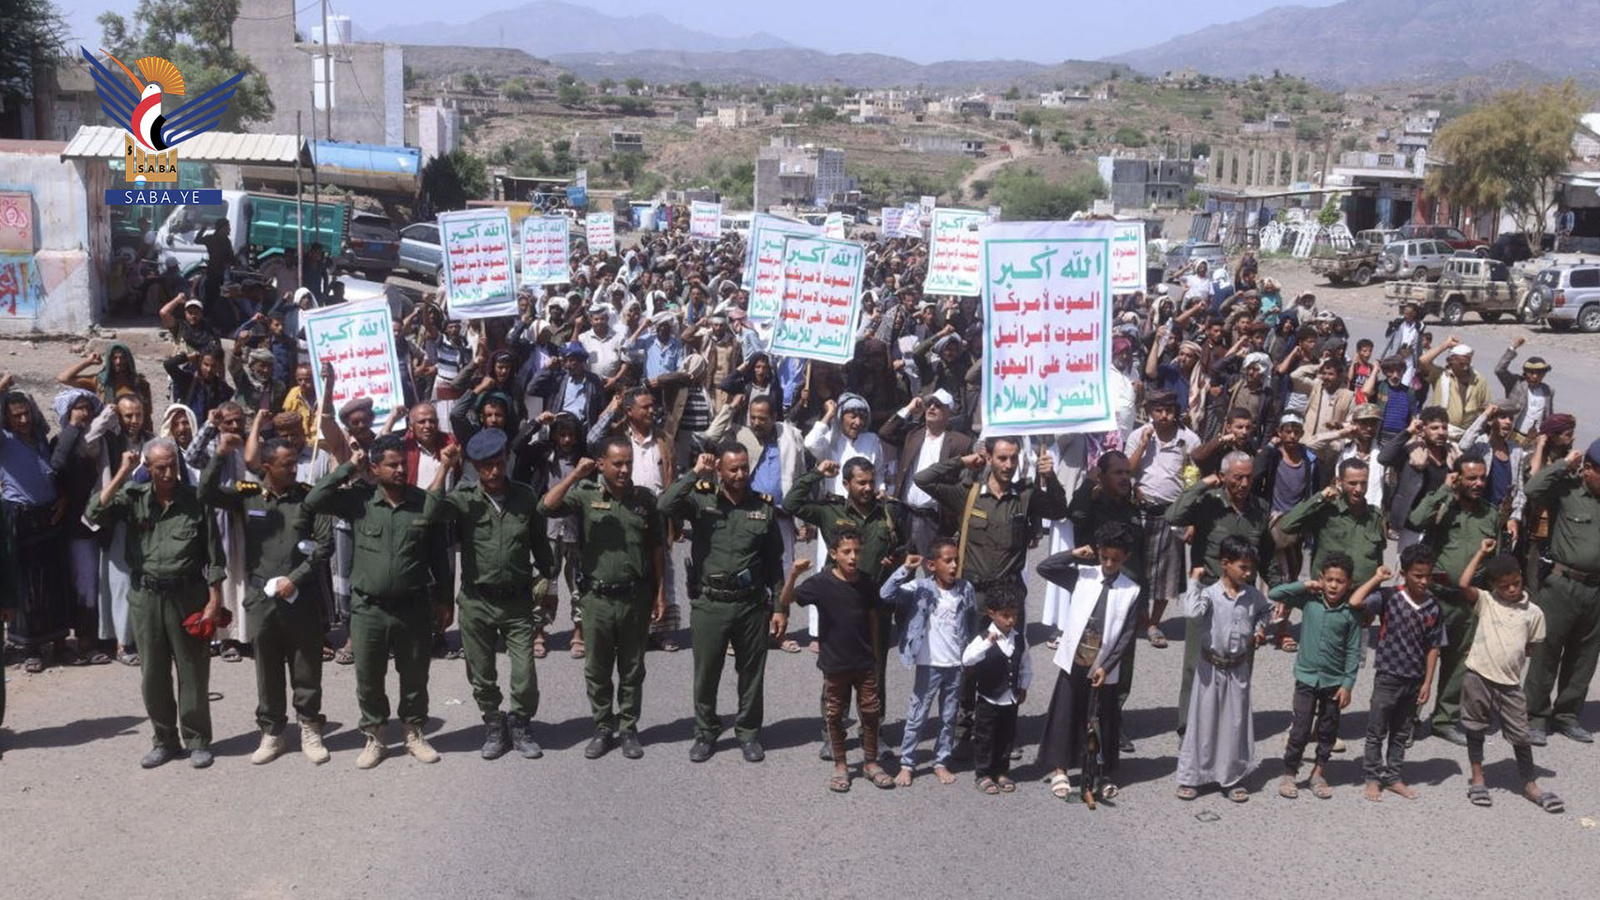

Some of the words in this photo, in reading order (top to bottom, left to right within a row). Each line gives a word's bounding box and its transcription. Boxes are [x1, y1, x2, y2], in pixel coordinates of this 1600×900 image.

[484, 223, 504, 237] الله
[831, 249, 857, 268] الله
[992, 245, 1058, 289] أكبر
[1060, 249, 1101, 279] الله
[823, 274, 855, 289] الموت
[821, 290, 852, 307] الموت
[993, 288, 1050, 317] لأمريكا
[1054, 291, 1100, 314] الموت
[779, 307, 805, 321] اليهود
[807, 311, 822, 324] على
[826, 311, 849, 326] اللعنة
[358, 318, 386, 337] الله
[994, 322, 1050, 348] لإسرائيل
[1054, 322, 1099, 346] الموت
[814, 329, 848, 348] النصر
[356, 342, 389, 360] الموت
[359, 361, 390, 379] الموت
[993, 355, 1034, 380] اليهود
[1039, 355, 1060, 379] على
[1065, 352, 1099, 374] اللعنة
[993, 383, 1048, 418] للإسلام
[1054, 379, 1100, 415] النصر
